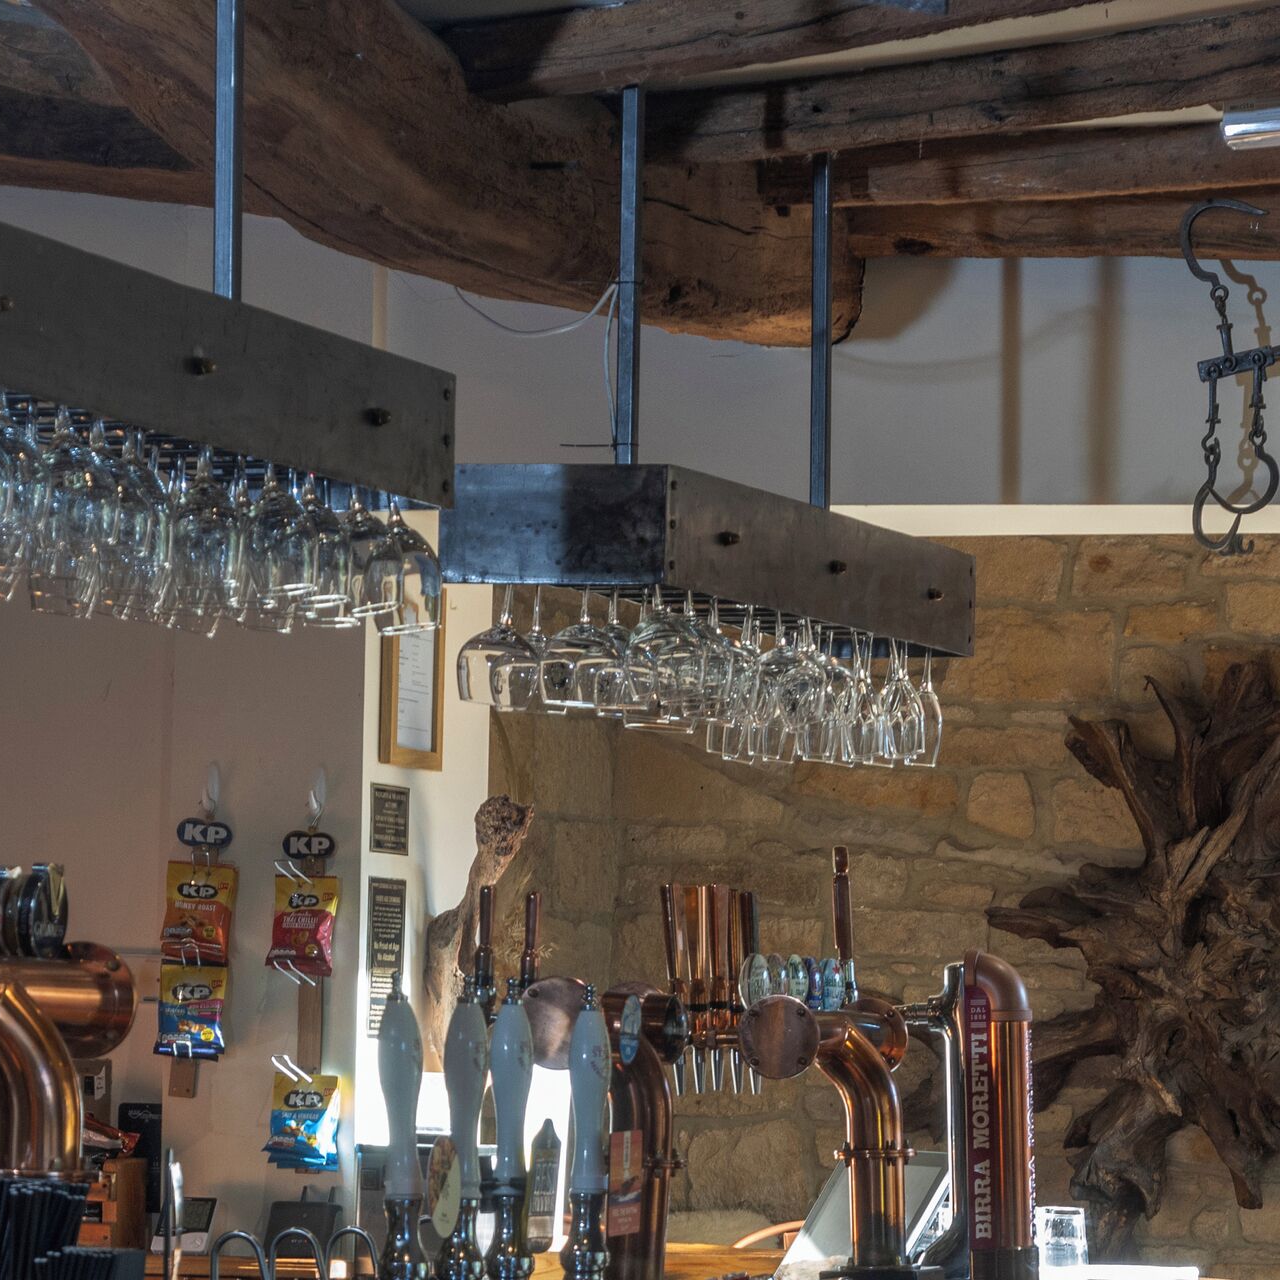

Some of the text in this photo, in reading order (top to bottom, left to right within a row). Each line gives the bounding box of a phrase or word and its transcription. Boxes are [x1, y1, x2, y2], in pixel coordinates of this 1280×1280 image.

[183, 824, 227, 844] KP
[289, 837, 330, 855] KP
[182, 885, 215, 897] KP
[175, 900, 217, 912] HONEY ROAST
[177, 986, 210, 999] KP
[288, 1093, 322, 1107] KP
[971, 1033, 993, 1240] BIRRA MORETTI
